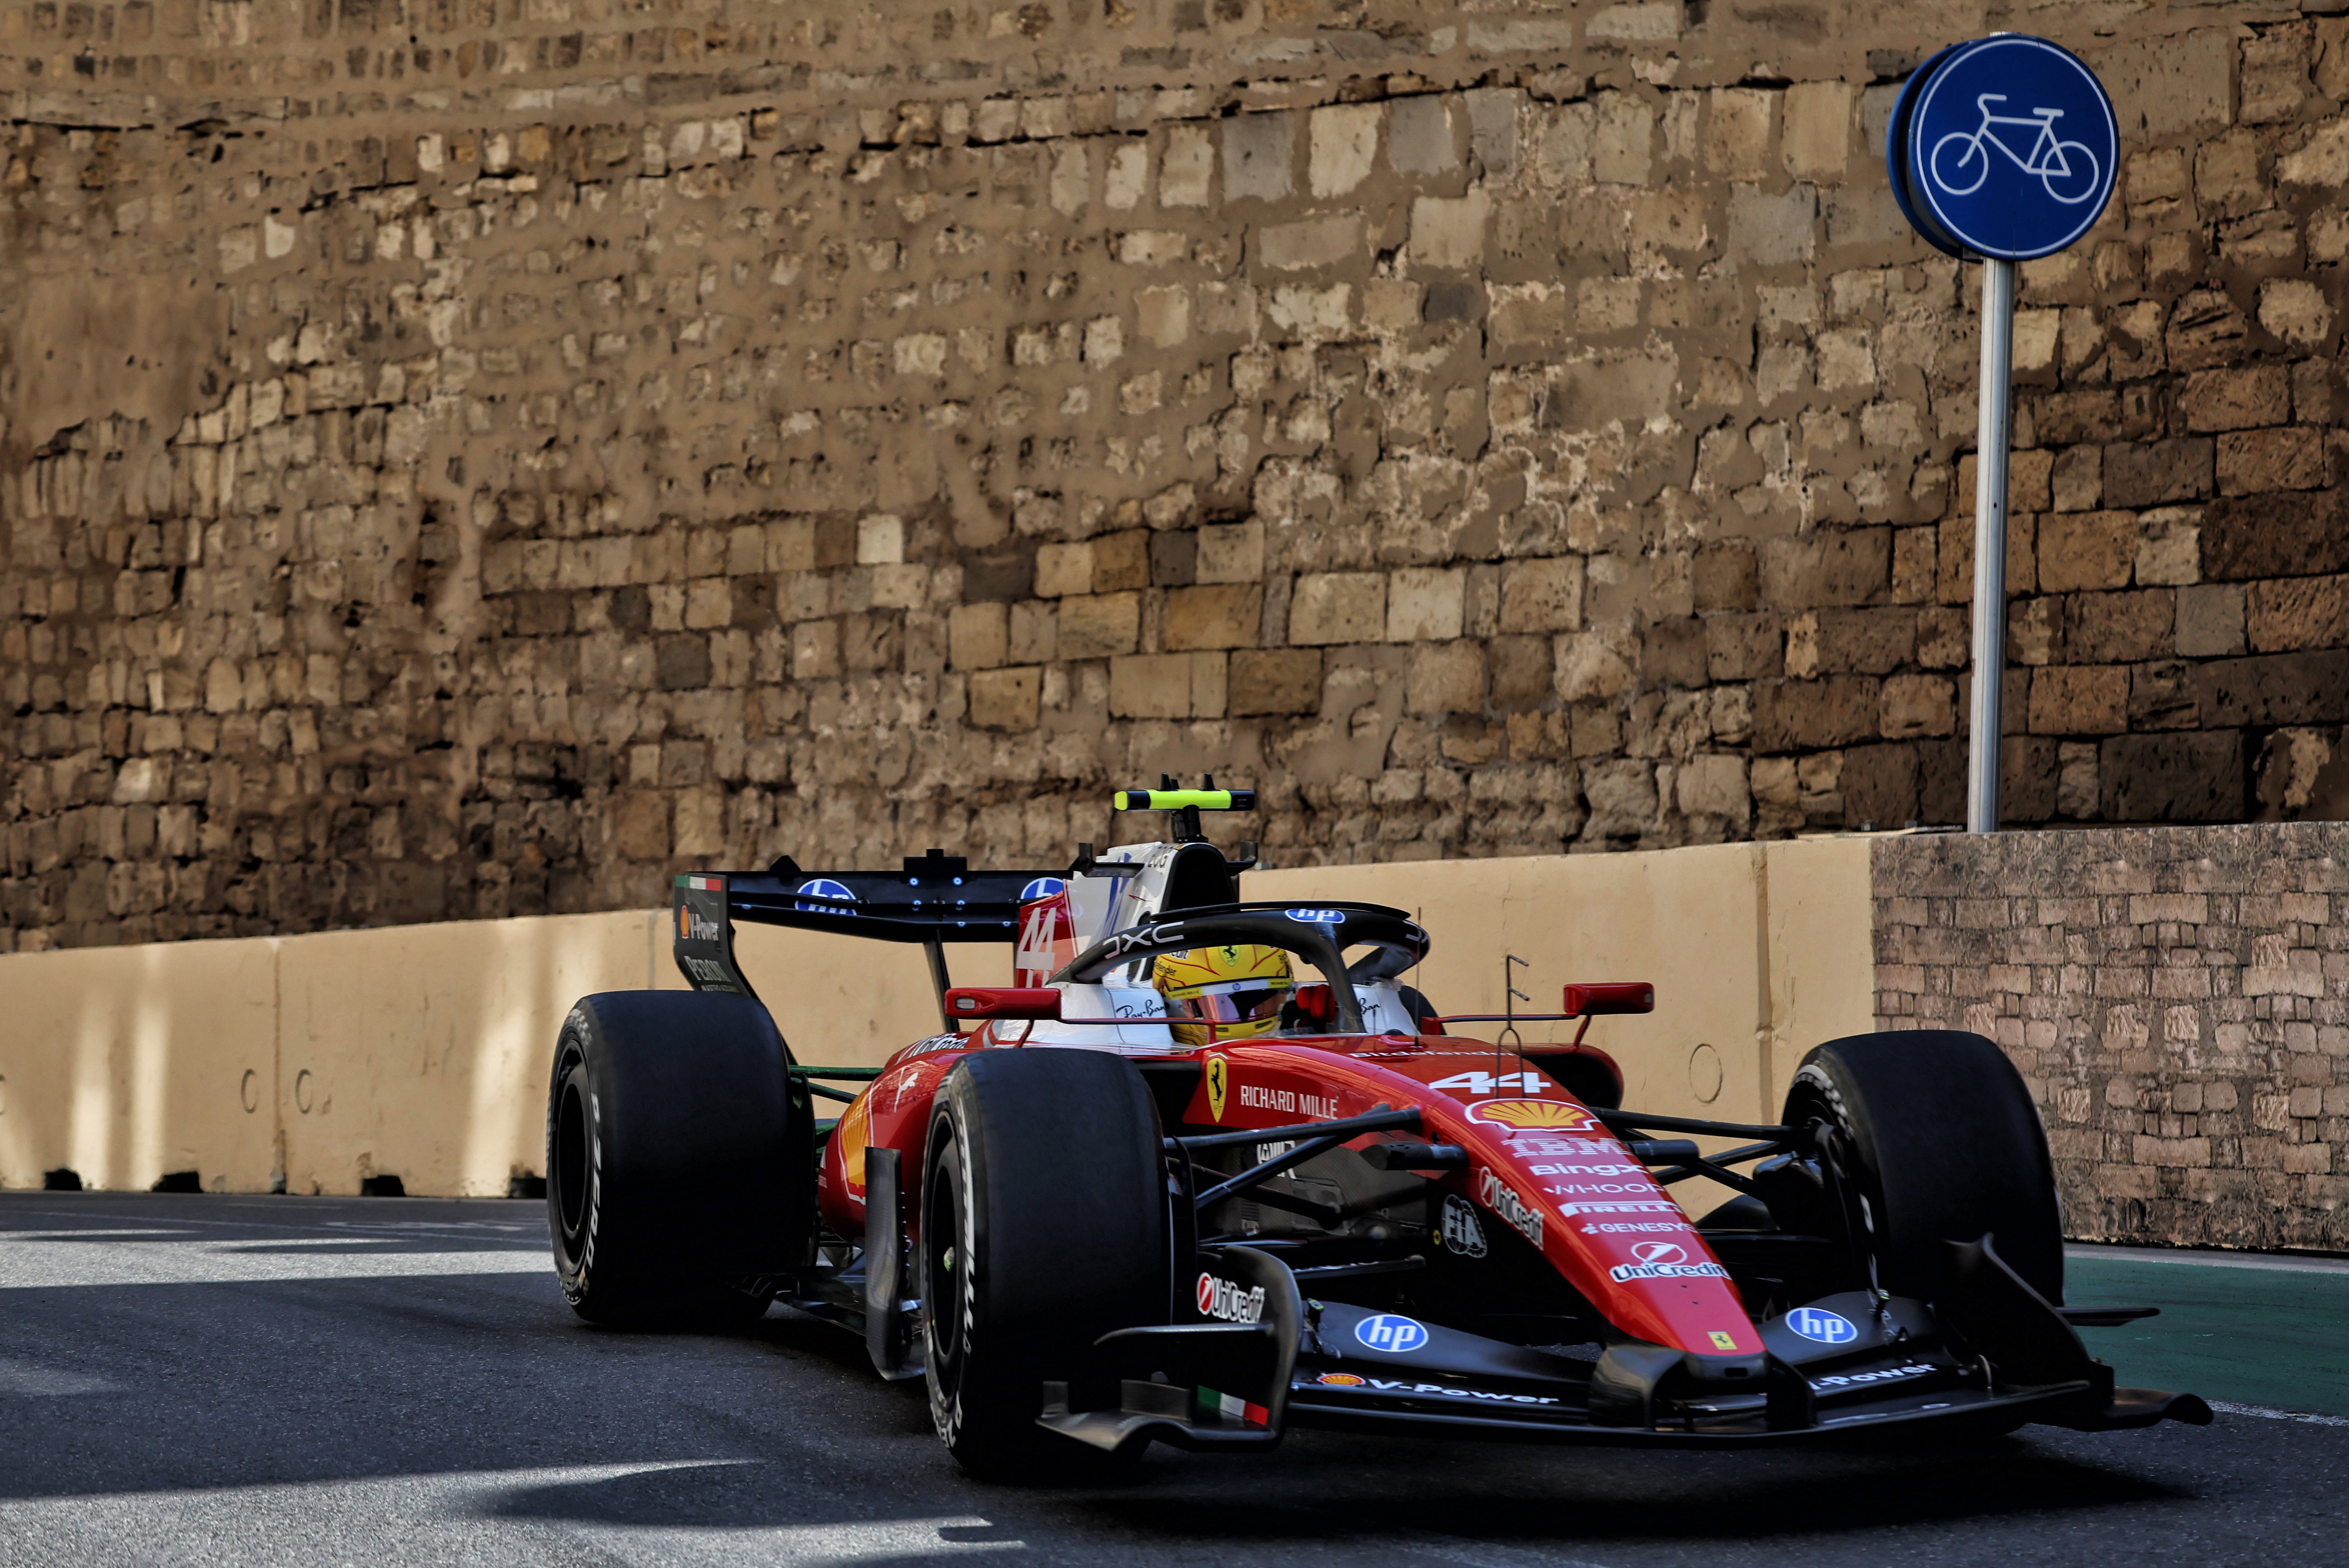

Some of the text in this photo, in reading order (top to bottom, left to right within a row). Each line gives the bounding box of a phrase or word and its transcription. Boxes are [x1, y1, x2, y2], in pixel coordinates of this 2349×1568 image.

[1297, 909, 1336, 921] hp
[1016, 907, 1057, 988] 44
[1428, 1071, 1551, 1093] 44
[1240, 1085, 1338, 1120] RICHARD MILLE
[1500, 1138, 1635, 1158] IBM
[1528, 1163, 1650, 1176] BingX
[1543, 1183, 1666, 1195] WHOOP
[1493, 1177, 1544, 1251] UniCredit
[1558, 1201, 1685, 1218] PIRELLI
[1598, 1222, 1702, 1234] GENESYS
[1609, 1262, 1733, 1283] UniCredit
[1213, 1277, 1265, 1323] UniCredit
[1368, 1315, 1417, 1351] hp
[1800, 1307, 1845, 1343] hp
[1366, 1379, 1560, 1404] V-Power
